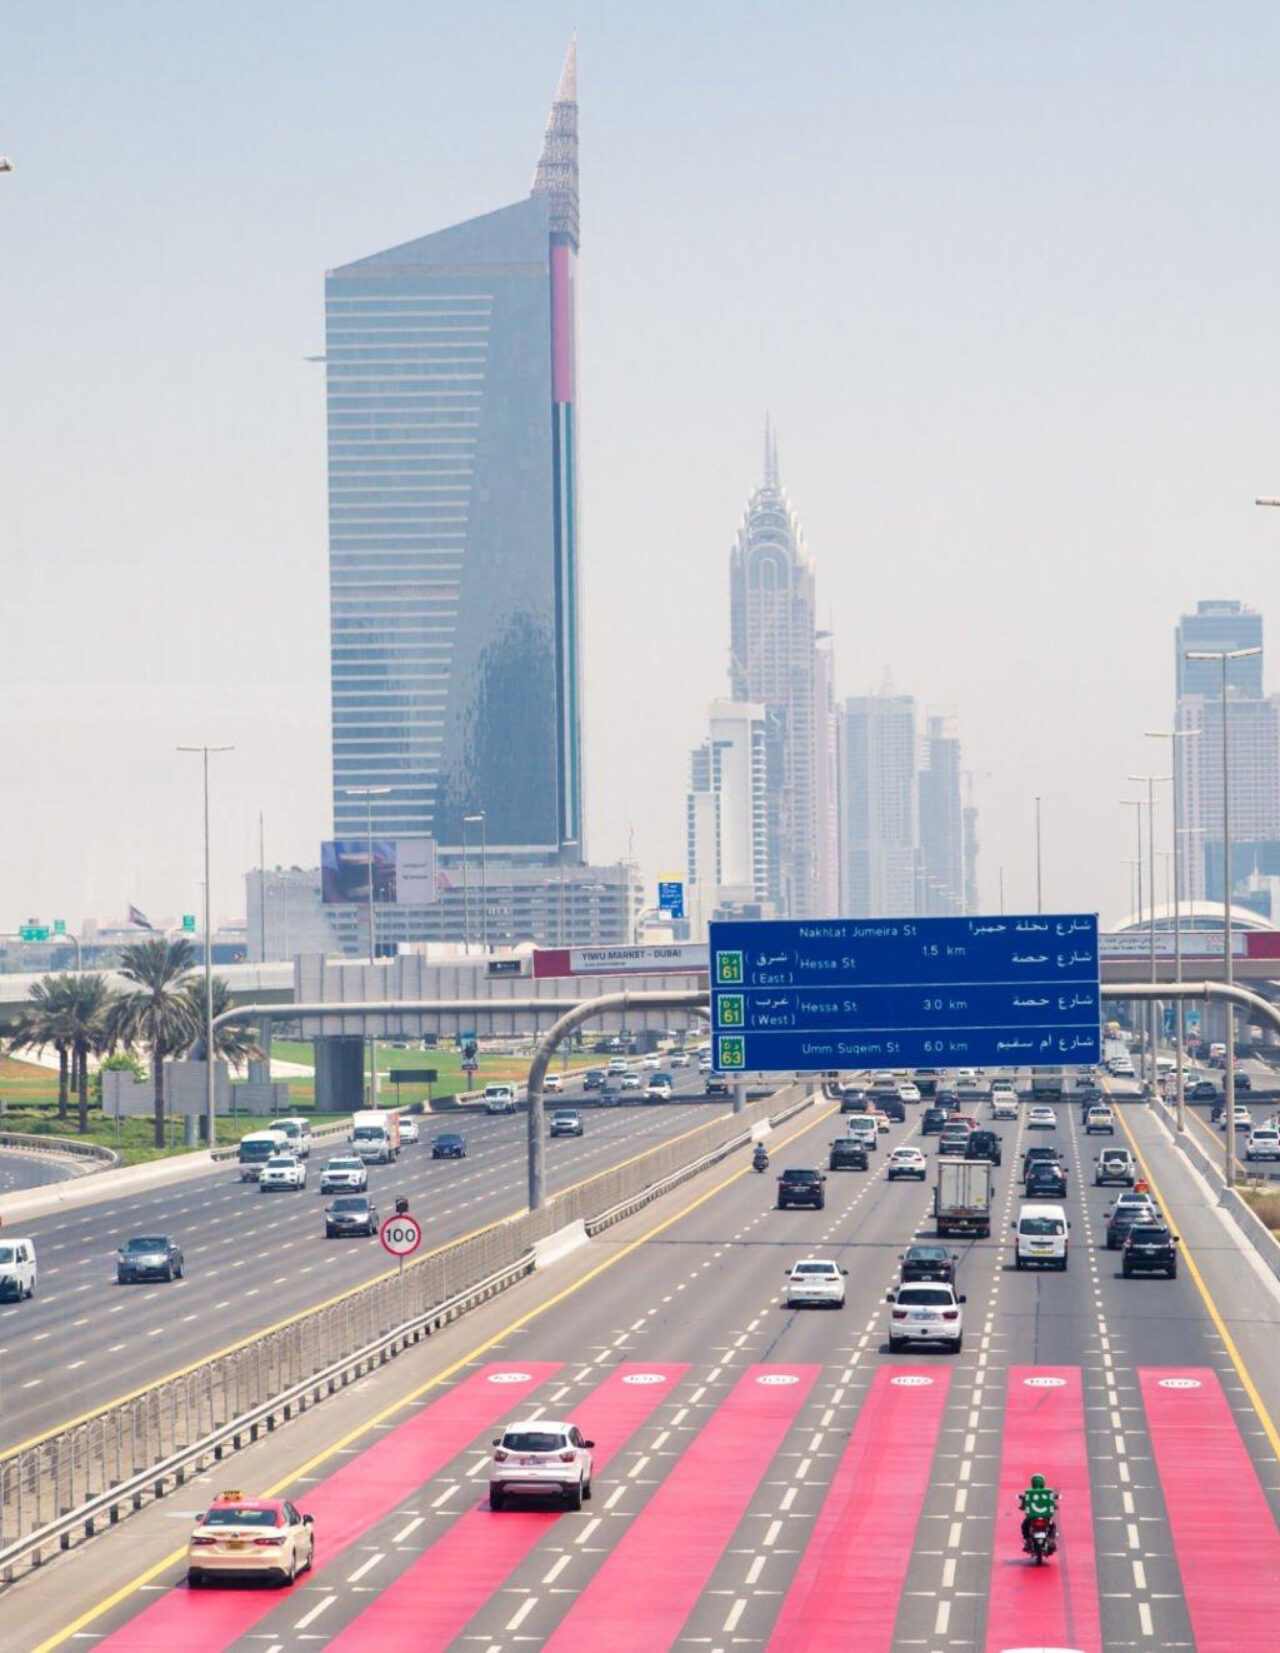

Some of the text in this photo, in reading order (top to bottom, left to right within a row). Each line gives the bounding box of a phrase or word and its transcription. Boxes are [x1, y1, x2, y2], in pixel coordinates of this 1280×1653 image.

[800, 924, 917, 938] Nakhlat Jumeira St
[1056, 919, 1091, 936] شارع
[582, 952, 606, 961] YIWU
[608, 949, 645, 960] MARKET
[653, 948, 682, 958] DUBAI
[923, 944, 966, 956] 1.5 km
[800, 957, 856, 969] Hessa St
[1057, 951, 1092, 968] شارع
[722, 965, 738, 979] 61
[801, 1001, 858, 1013] Hessa St
[949, 999, 968, 1010] km
[1058, 994, 1094, 1010] شارع
[723, 1009, 740, 1023] 61
[802, 1041, 900, 1056] Umm Suqeim St
[924, 1040, 968, 1052] 6.0 km
[1058, 1035, 1094, 1051] شارع
[722, 1050, 741, 1065] 63
[386, 1228, 416, 1243] 100
